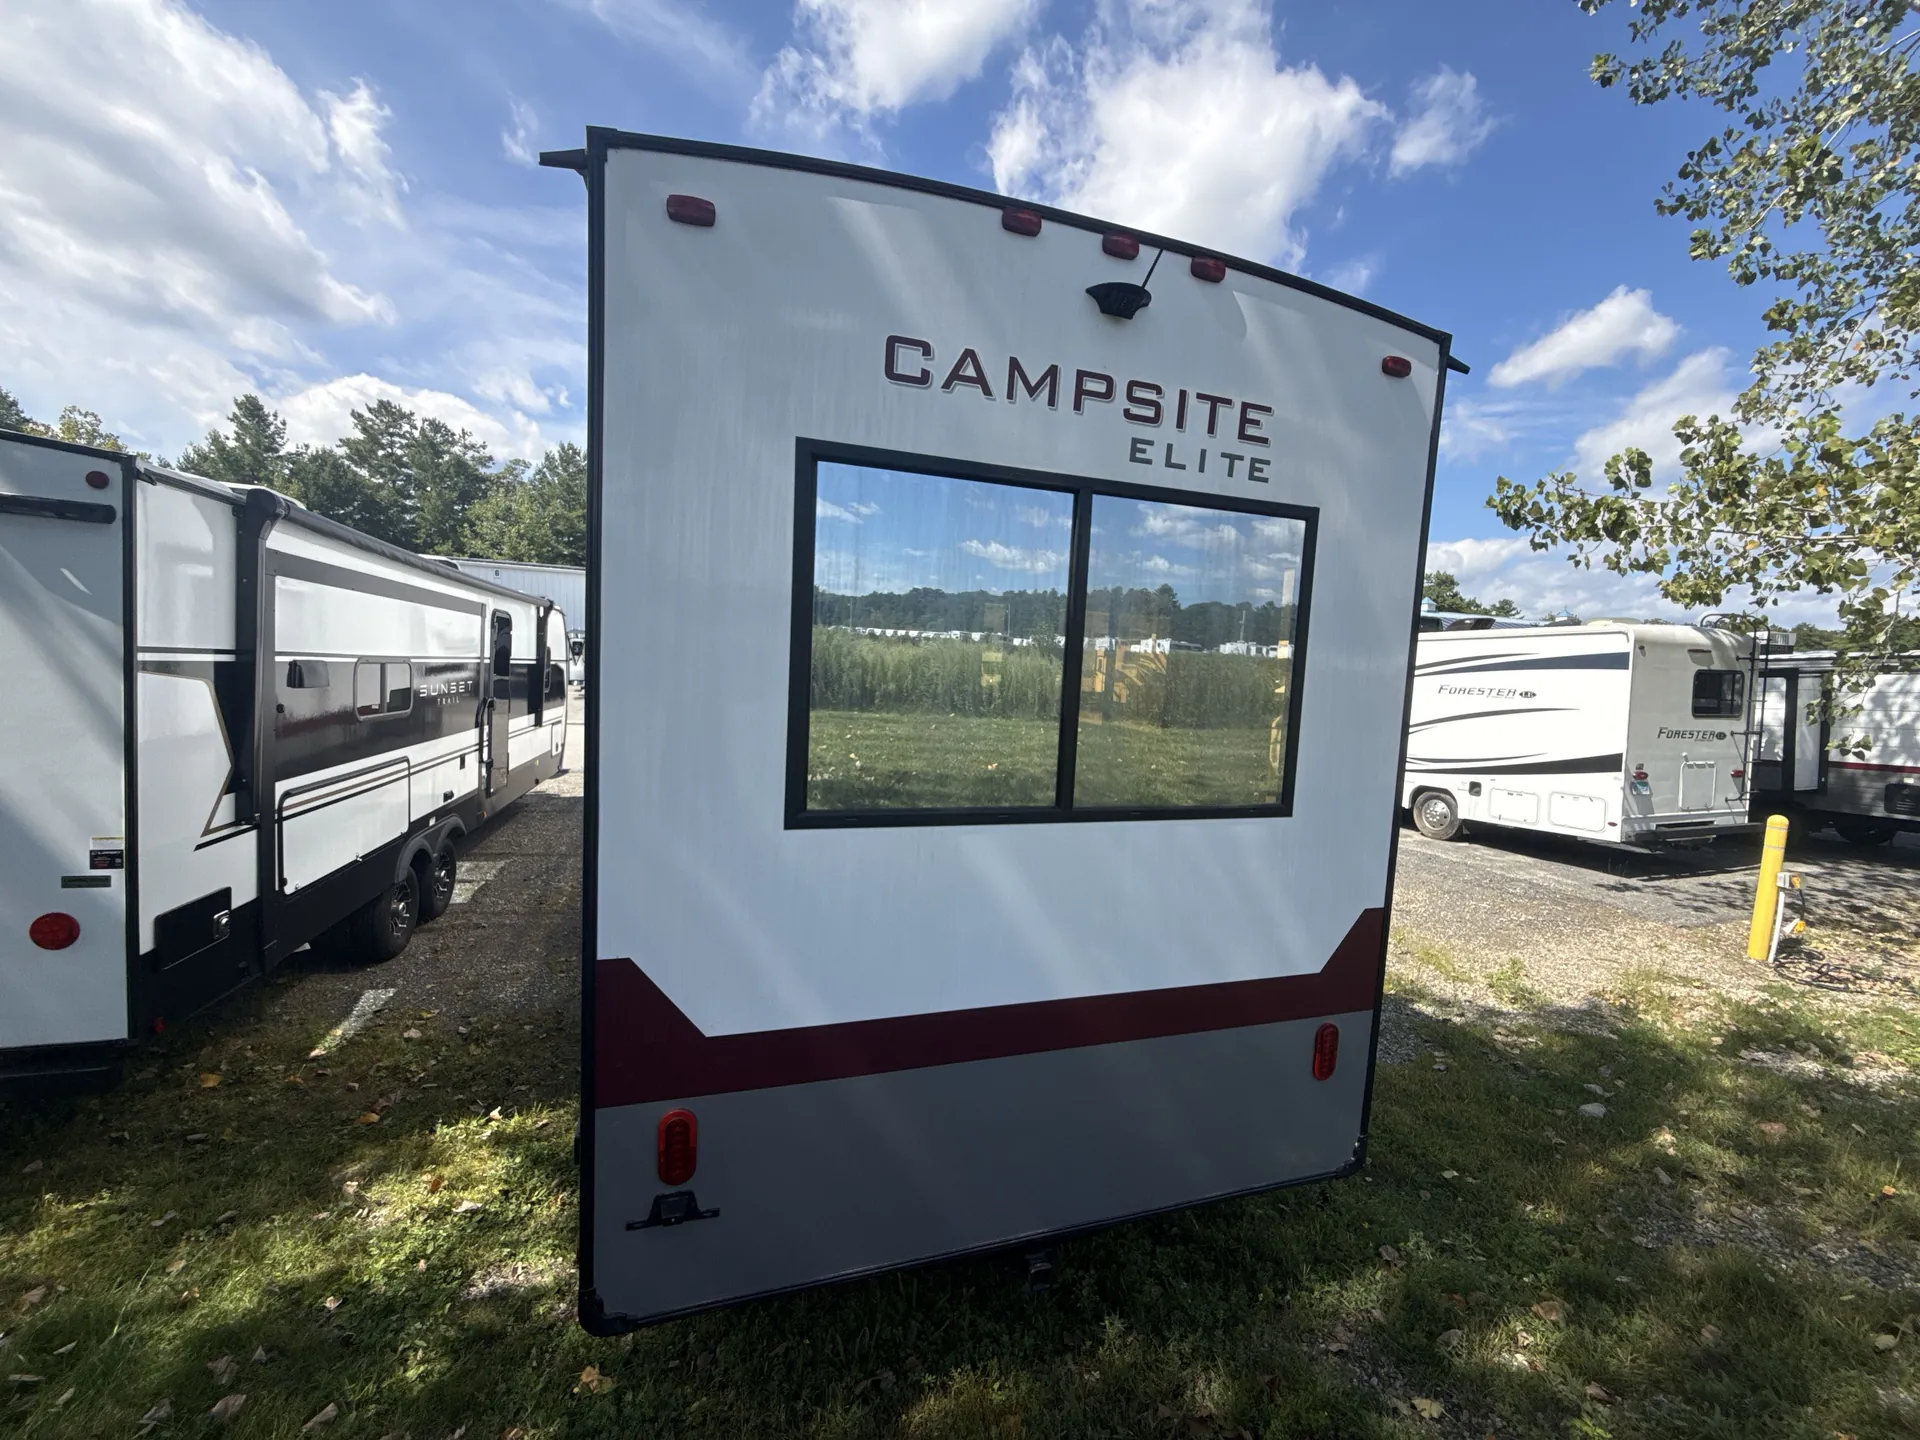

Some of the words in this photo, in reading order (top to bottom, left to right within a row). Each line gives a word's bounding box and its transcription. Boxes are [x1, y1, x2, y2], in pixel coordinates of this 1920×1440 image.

[884, 334, 1274, 446] CAMPSITE
[1129, 437, 1271, 483] ELITE
[419, 680, 473, 697] SUNSET
[437, 696, 460, 706] TRAIL
